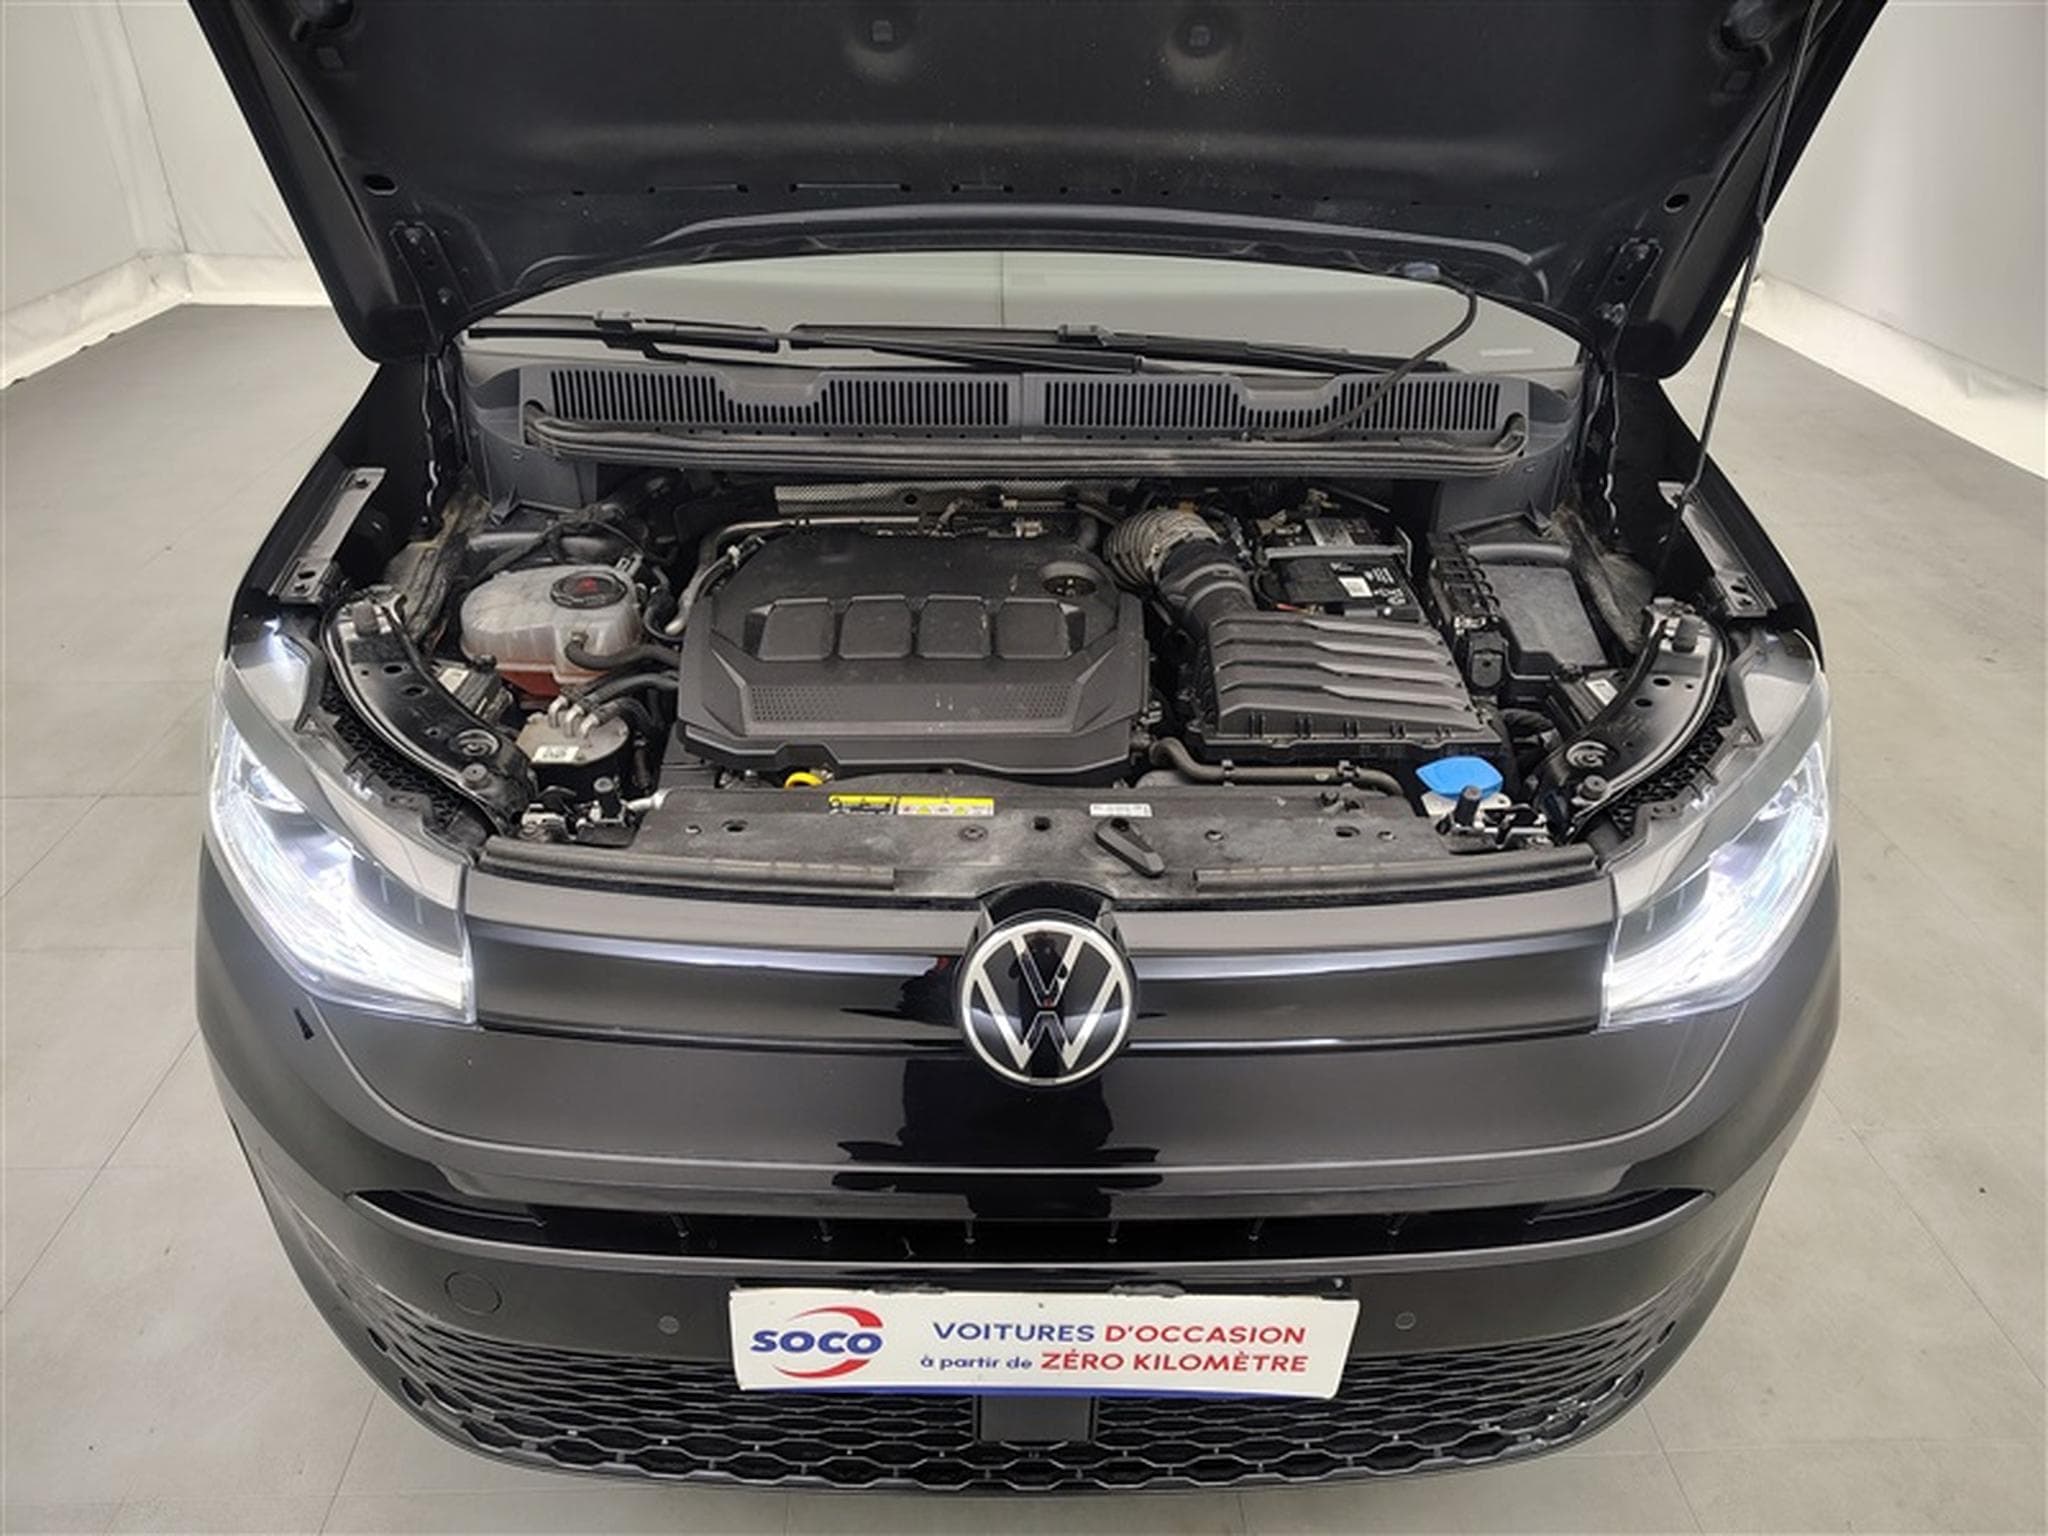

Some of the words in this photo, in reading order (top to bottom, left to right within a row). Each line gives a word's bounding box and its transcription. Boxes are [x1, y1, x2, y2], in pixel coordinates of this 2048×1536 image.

[750, 1329, 883, 1355] SOCO
[933, 1321, 1095, 1342] VOITURES
[1104, 1325, 1306, 1345] D'OCCASION
[920, 1354, 934, 1369] à
[940, 1356, 1000, 1371] partir
[1006, 1355, 1033, 1370] de
[1041, 1349, 1125, 1371] ZÉRO
[1133, 1352, 1309, 1372] KILOMÈTRE
